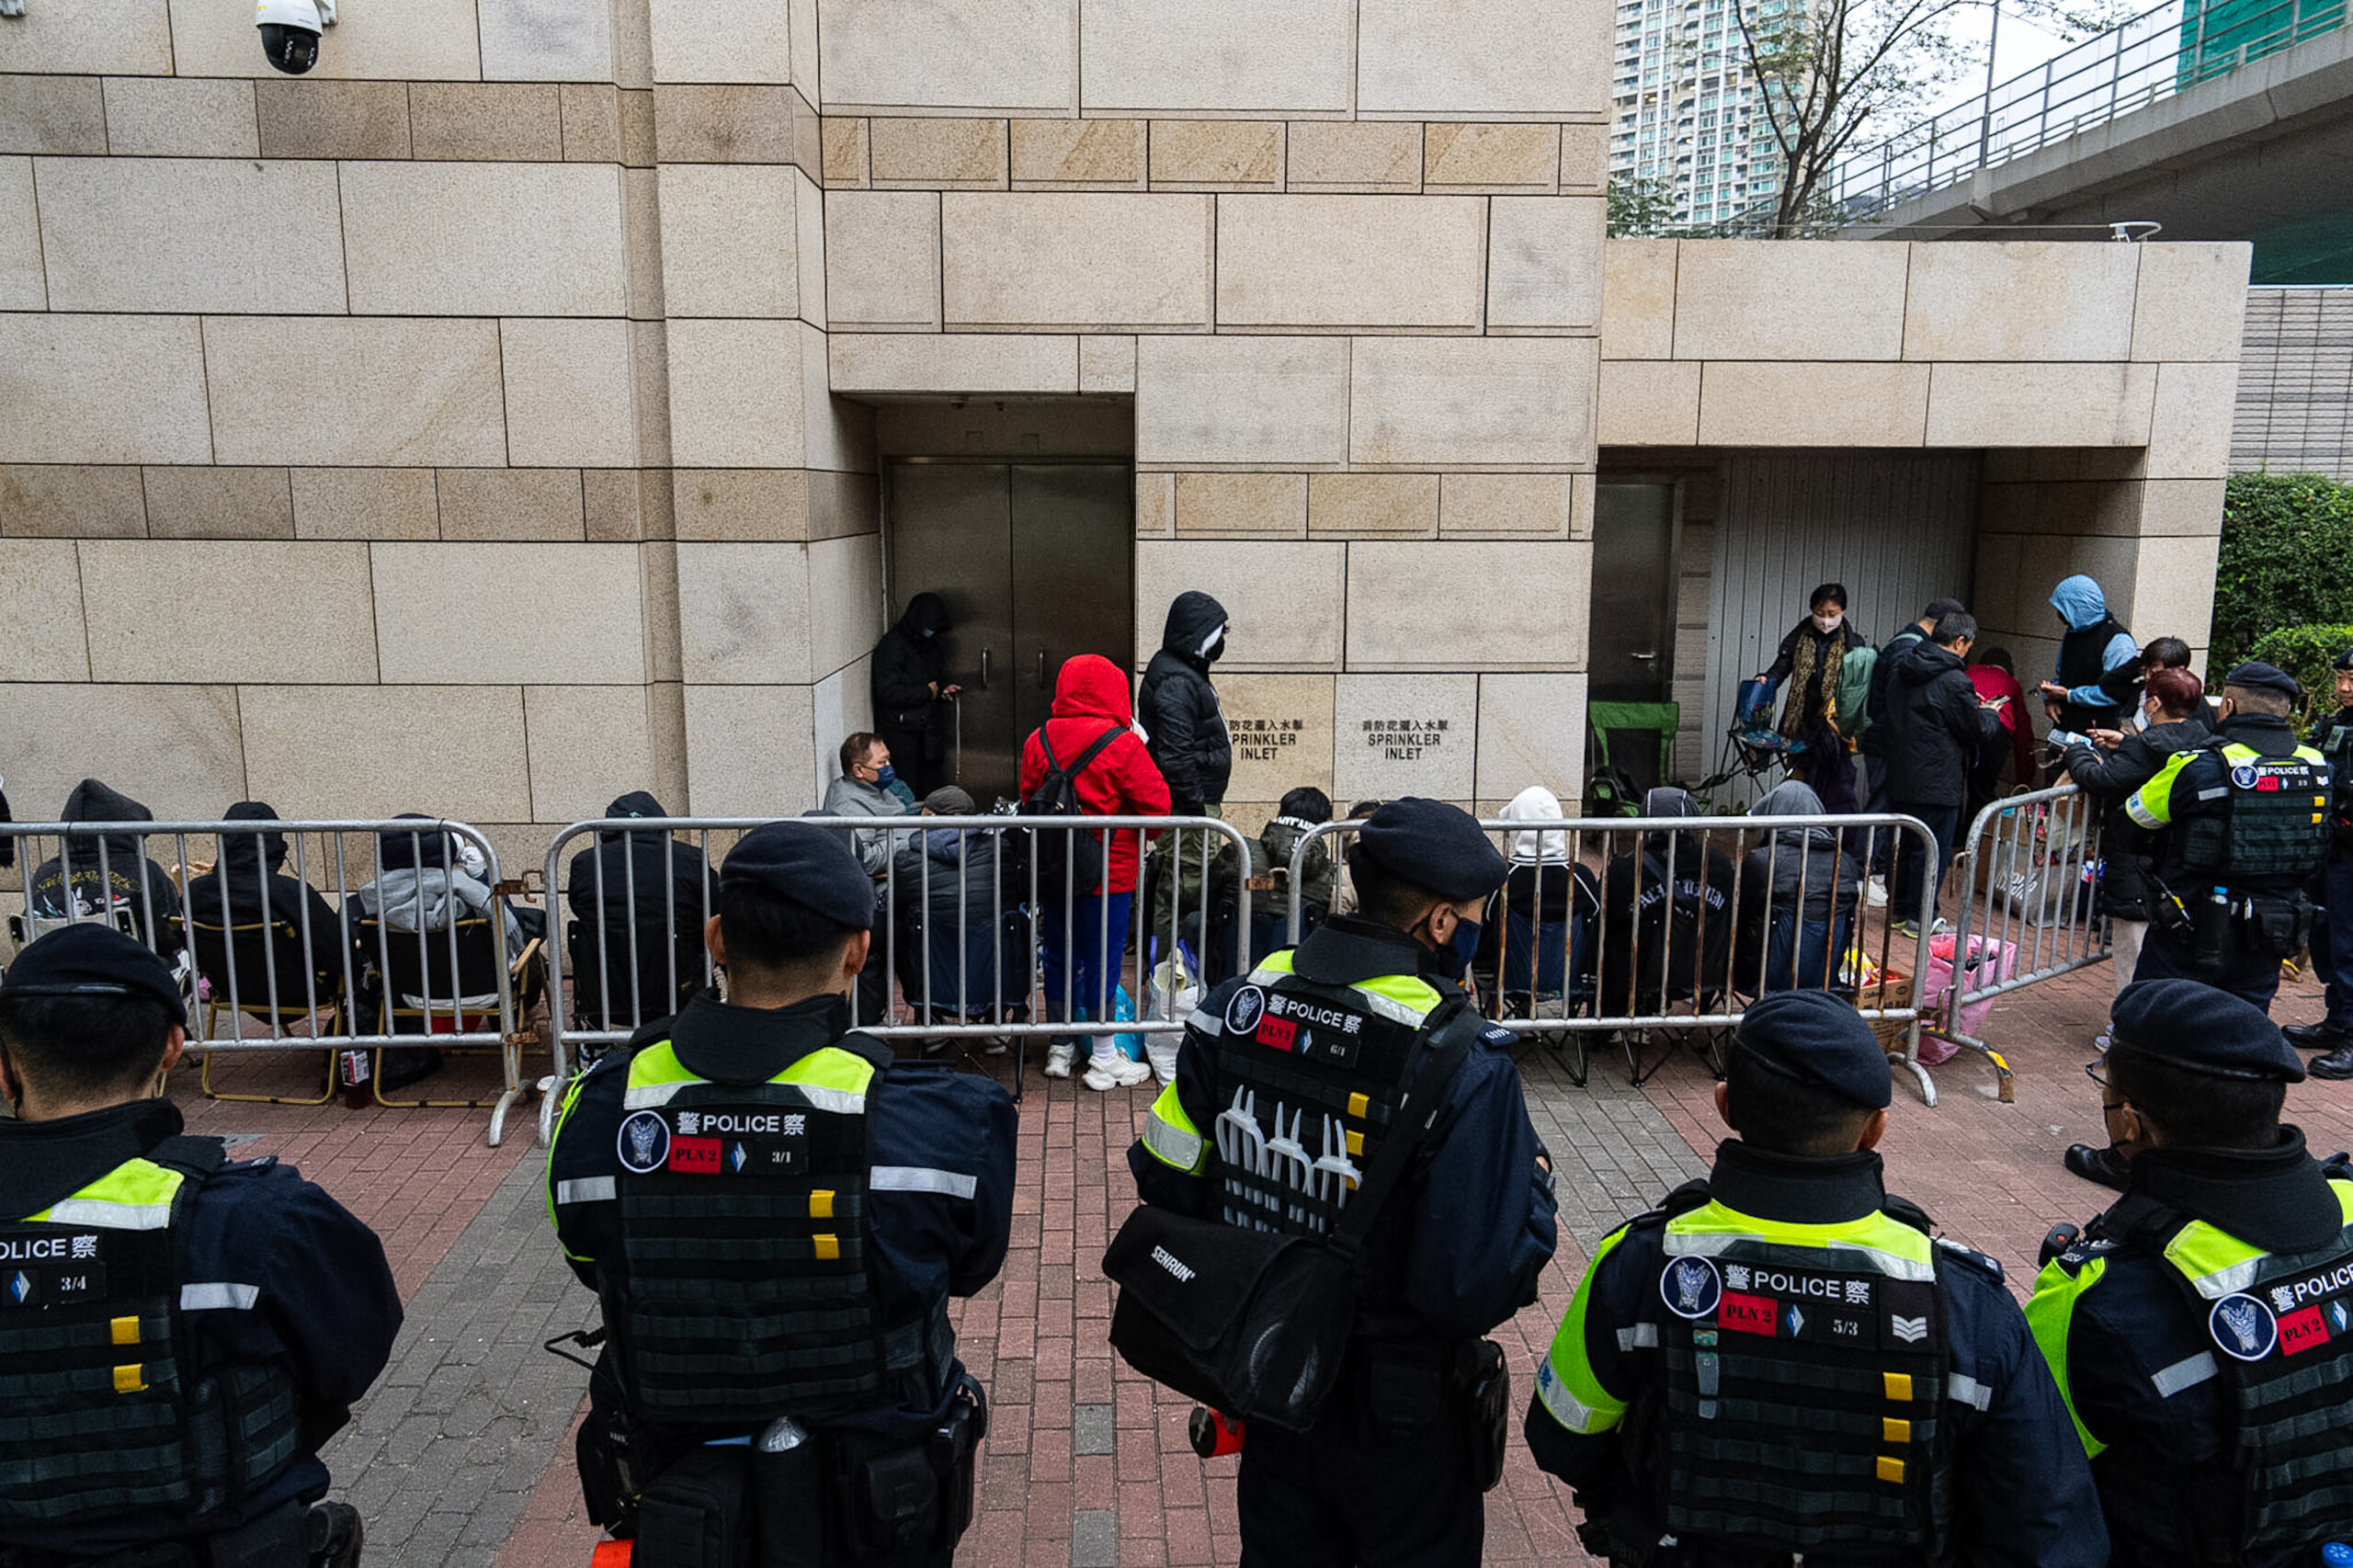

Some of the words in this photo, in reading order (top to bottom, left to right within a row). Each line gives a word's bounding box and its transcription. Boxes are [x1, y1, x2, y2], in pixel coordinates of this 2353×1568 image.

[1230, 733, 1296, 746] PRINKLER
[1368, 733, 1440, 746] SPRINKLER
[1240, 747, 1279, 760] INLET
[1385, 747, 1422, 760] INLET
[1286, 1000, 1345, 1028] POLICE
[703, 1115, 780, 1133] POLICE
[1151, 1244, 1193, 1282] SENRUN
[61, 1275, 87, 1291] 3/4
[1754, 1271, 1841, 1299] POLICE
[1833, 1319, 1859, 1336] 5/3
